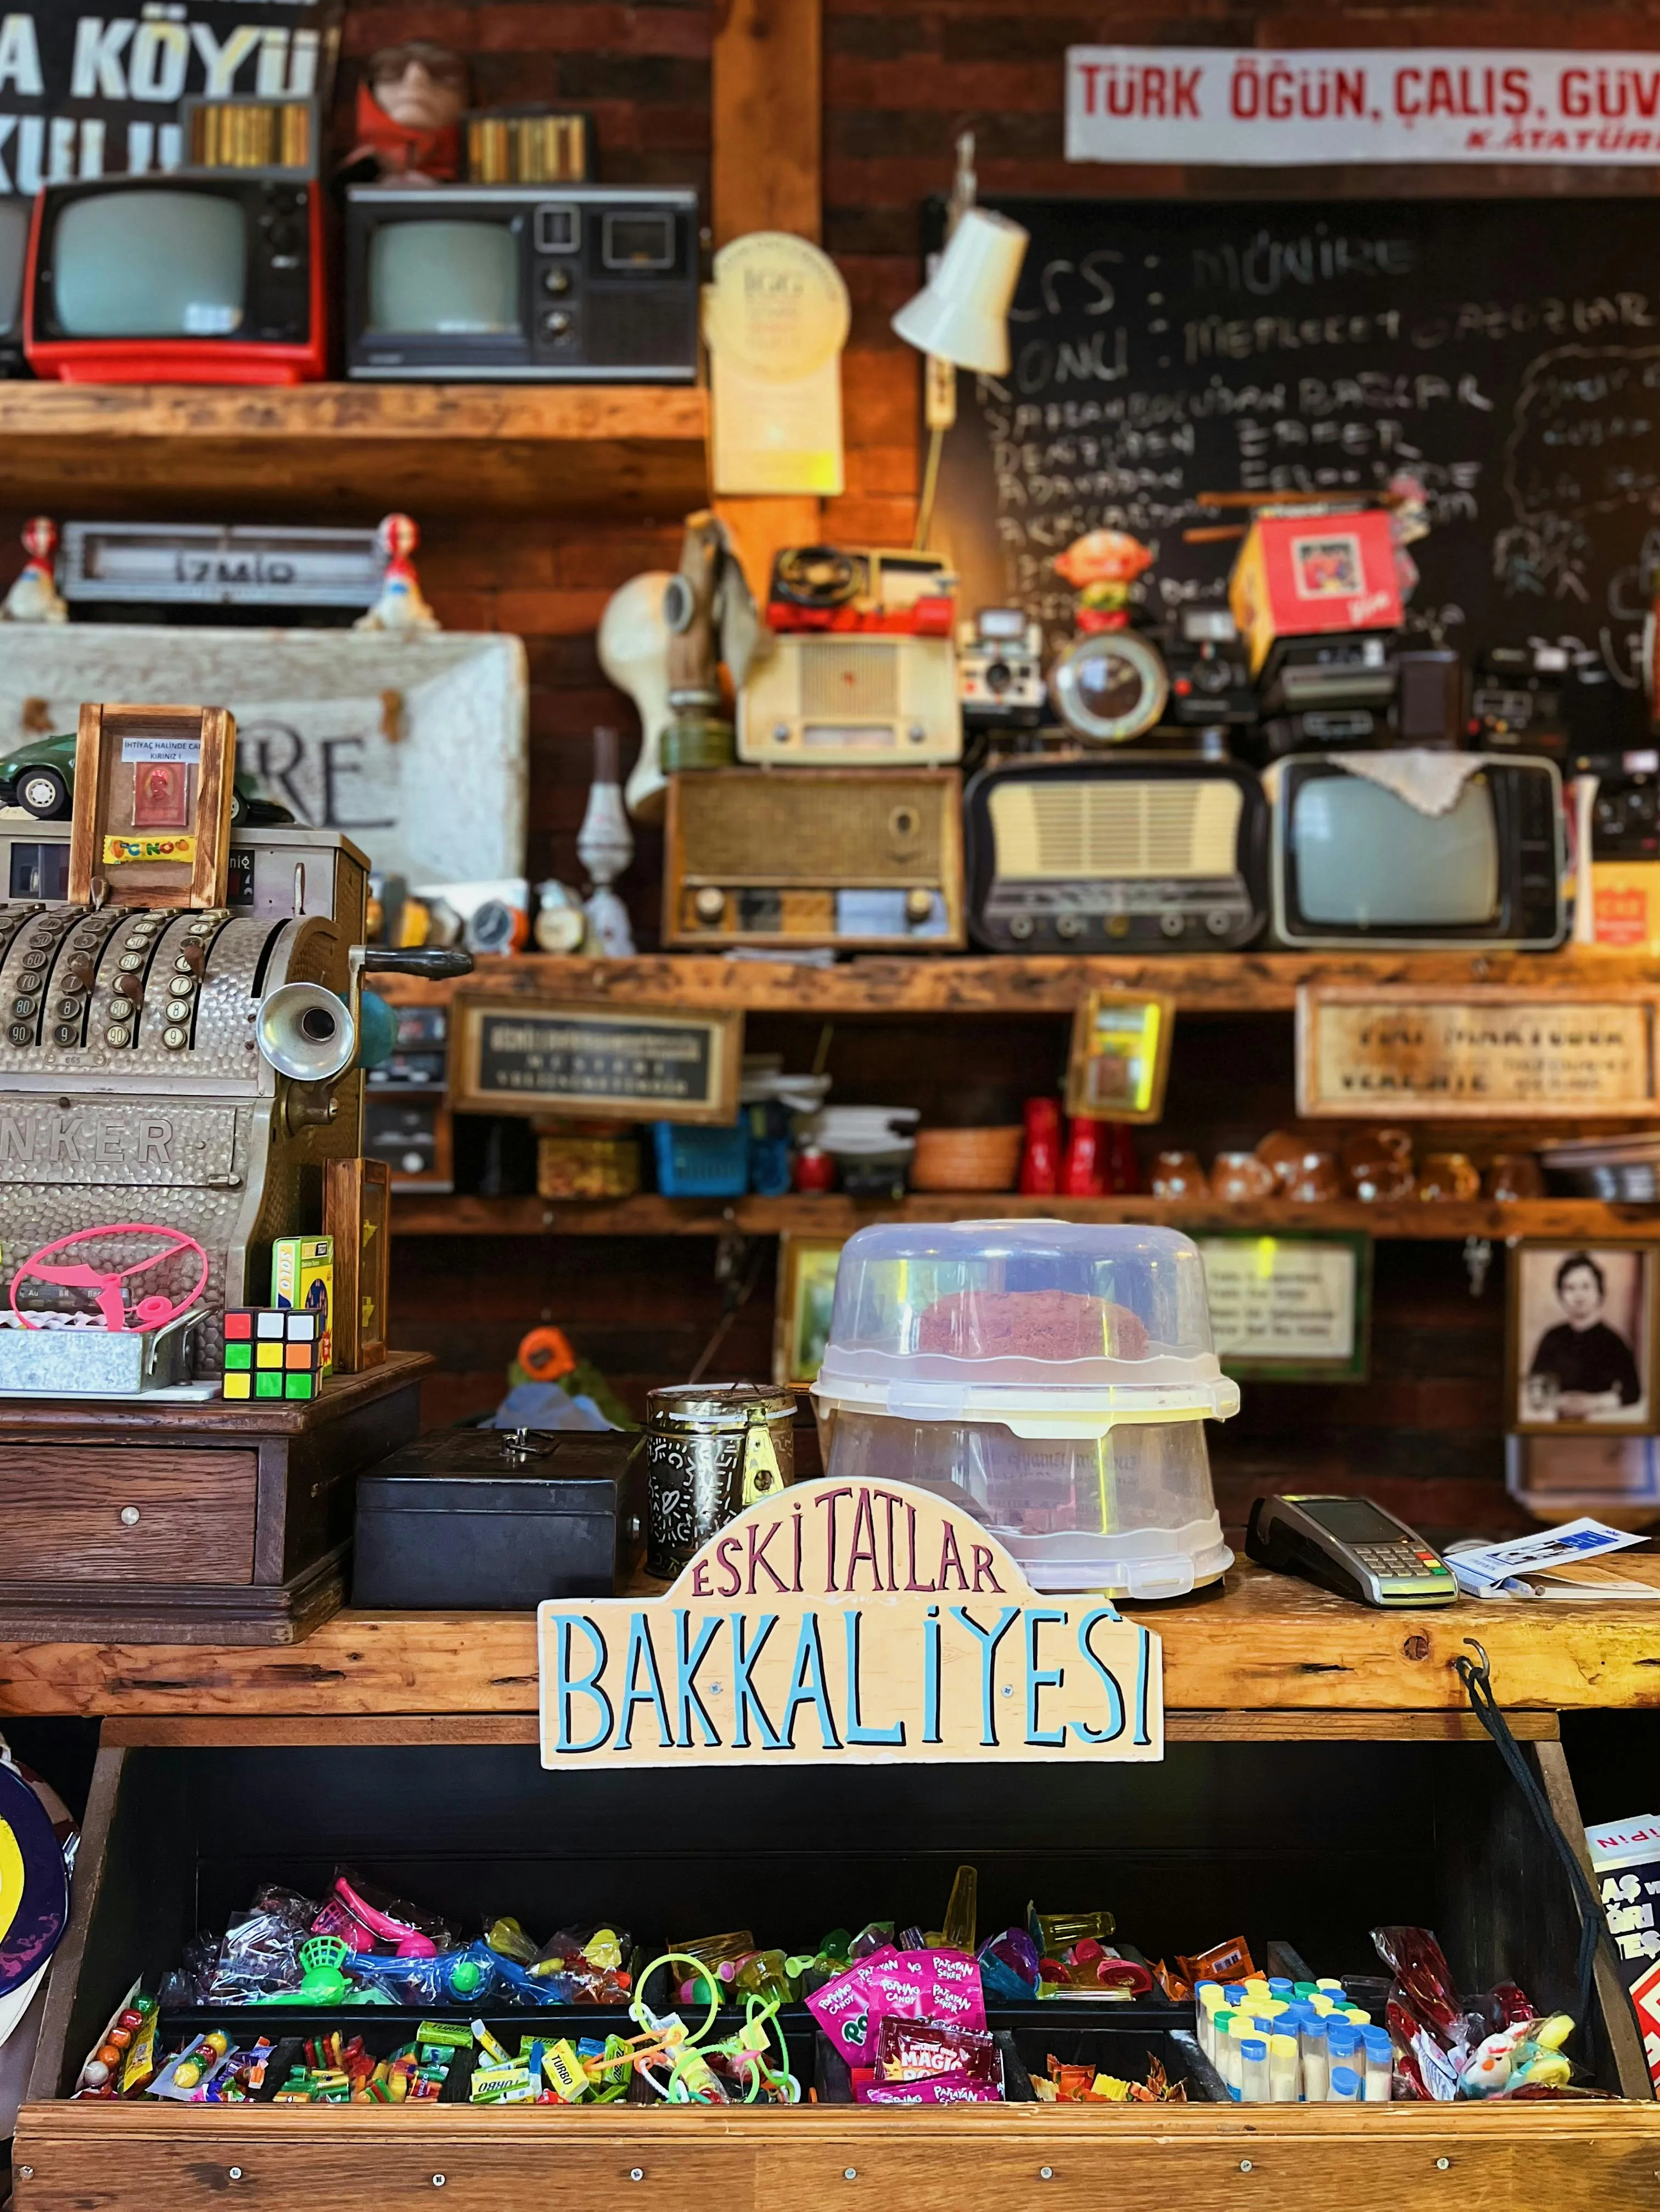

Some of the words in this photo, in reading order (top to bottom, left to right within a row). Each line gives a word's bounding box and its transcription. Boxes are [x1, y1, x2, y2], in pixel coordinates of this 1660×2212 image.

[71, 3, 320, 102] KÖYÜ
[1079, 64, 1203, 119] TÜRK
[1560, 67, 1660, 118] GÜV
[1467, 127, 1660, 151] K.ATATÜR
[236, 719, 397, 830] RE
[35, 935, 48, 946] 50
[83, 937, 89, 946] 5
[27, 954, 41, 965] 60
[124, 956, 138, 967] 60
[21, 975, 35, 985] 70
[70, 976, 76, 986] 7
[178, 979, 184, 991] 7
[16, 1001, 30, 1014] 80
[64, 1001, 71, 1015] 8
[113, 1002, 126, 1015] 80
[173, 1003, 180, 1017] 8
[13, 1030, 26, 1041] 90
[61, 1027, 68, 1041] 9
[110, 1029, 123, 1043] 90
[170, 1030, 177, 1044] 9
[0, 1117, 173, 1164] NKER
[692, 1502, 805, 1597] ESKİ
[814, 1487, 1007, 1593] TATLAR
[1597, 1874, 1641, 1904] AŞ
[1606, 1902, 1655, 1934] ĞRI
[933, 1956, 974, 1977] PATLAYAN
[881, 1979, 921, 1995] POPPING
[818, 1983, 852, 2010] POPPING
[885, 1992, 917, 2005] CANDY
[933, 1984, 972, 2011] PATLAYAN
[828, 1994, 854, 2015] CANDY
[431, 2024, 471, 2034] TURBO
[551, 2054, 574, 2085] TURBO
[933, 2085, 978, 2102] PATLAYAN
